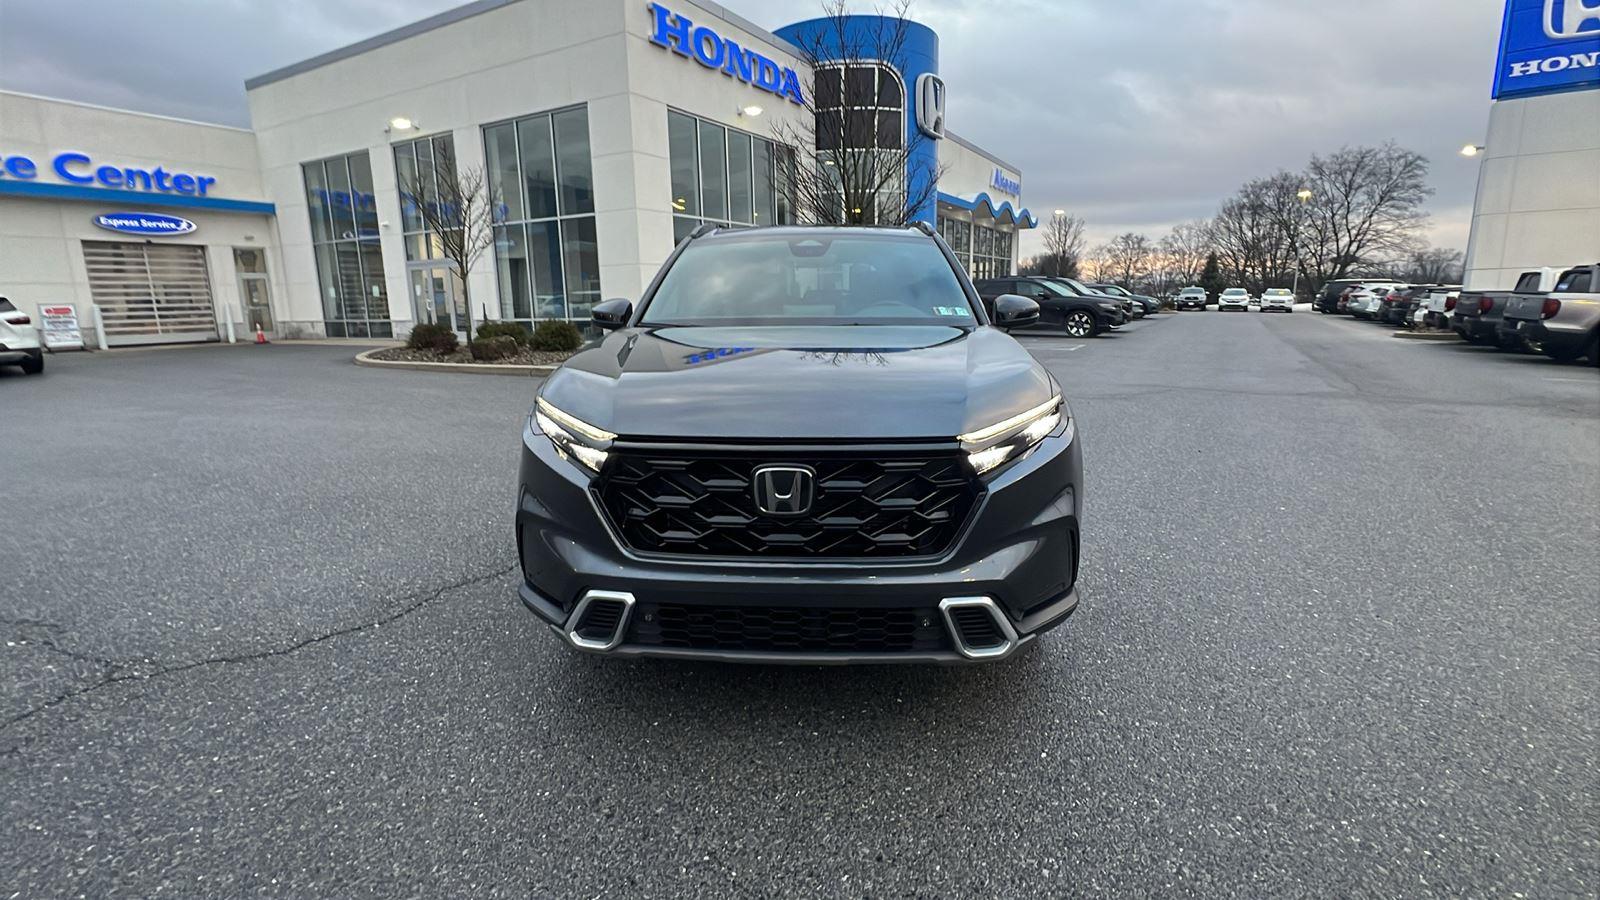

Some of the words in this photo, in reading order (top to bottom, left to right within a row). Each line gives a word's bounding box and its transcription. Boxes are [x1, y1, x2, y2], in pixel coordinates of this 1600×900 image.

[648, 2, 803, 105] HONDA
[1508, 52, 1600, 77] HON
[0, 155, 37, 179] e
[53, 152, 216, 195] Center
